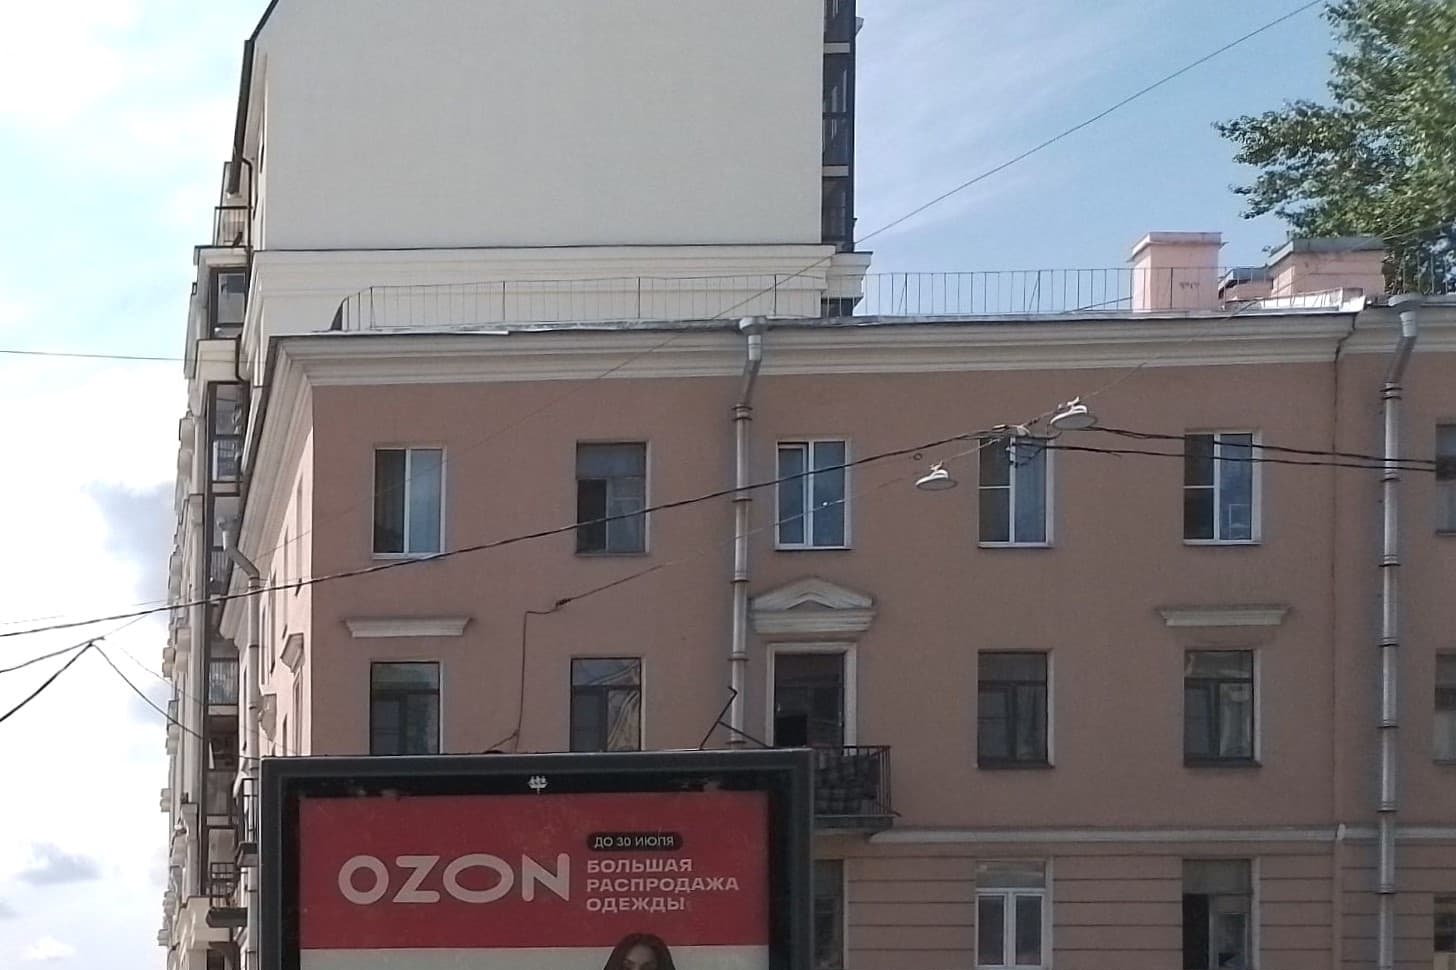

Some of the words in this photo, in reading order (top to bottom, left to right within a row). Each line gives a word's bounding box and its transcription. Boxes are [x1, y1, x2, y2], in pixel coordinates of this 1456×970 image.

[595, 835, 613, 848] ДО
[616, 836, 631, 847] 30
[636, 836, 674, 847] ИЮЛЯ
[587, 859, 692, 873] БОЛЬШАЯ
[338, 853, 570, 904] OZON
[587, 877, 739, 894] РАСПРОДАЖА
[587, 896, 685, 913] ОДЕЖДЫ
